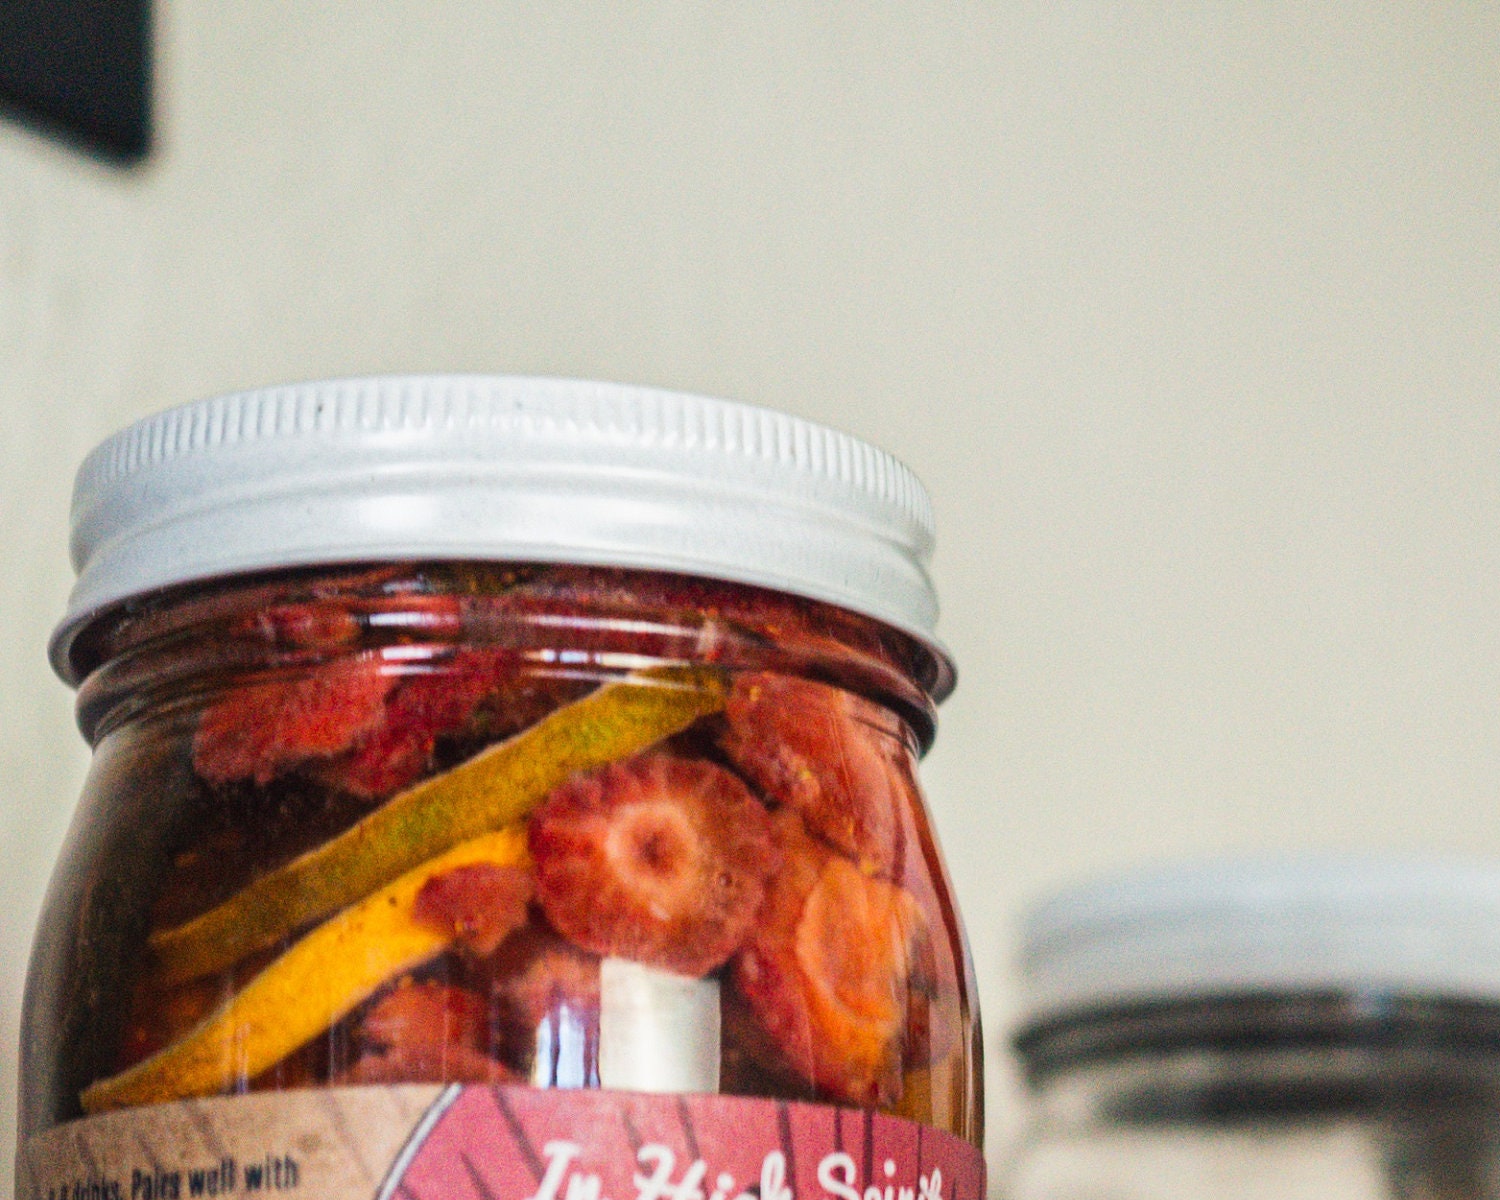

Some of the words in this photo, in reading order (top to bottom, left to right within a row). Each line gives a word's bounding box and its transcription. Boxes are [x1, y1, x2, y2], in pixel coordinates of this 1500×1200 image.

[131, 1168, 181, 1200] Pairs
[188, 1157, 236, 1197] well
[244, 1153, 298, 1191] with
